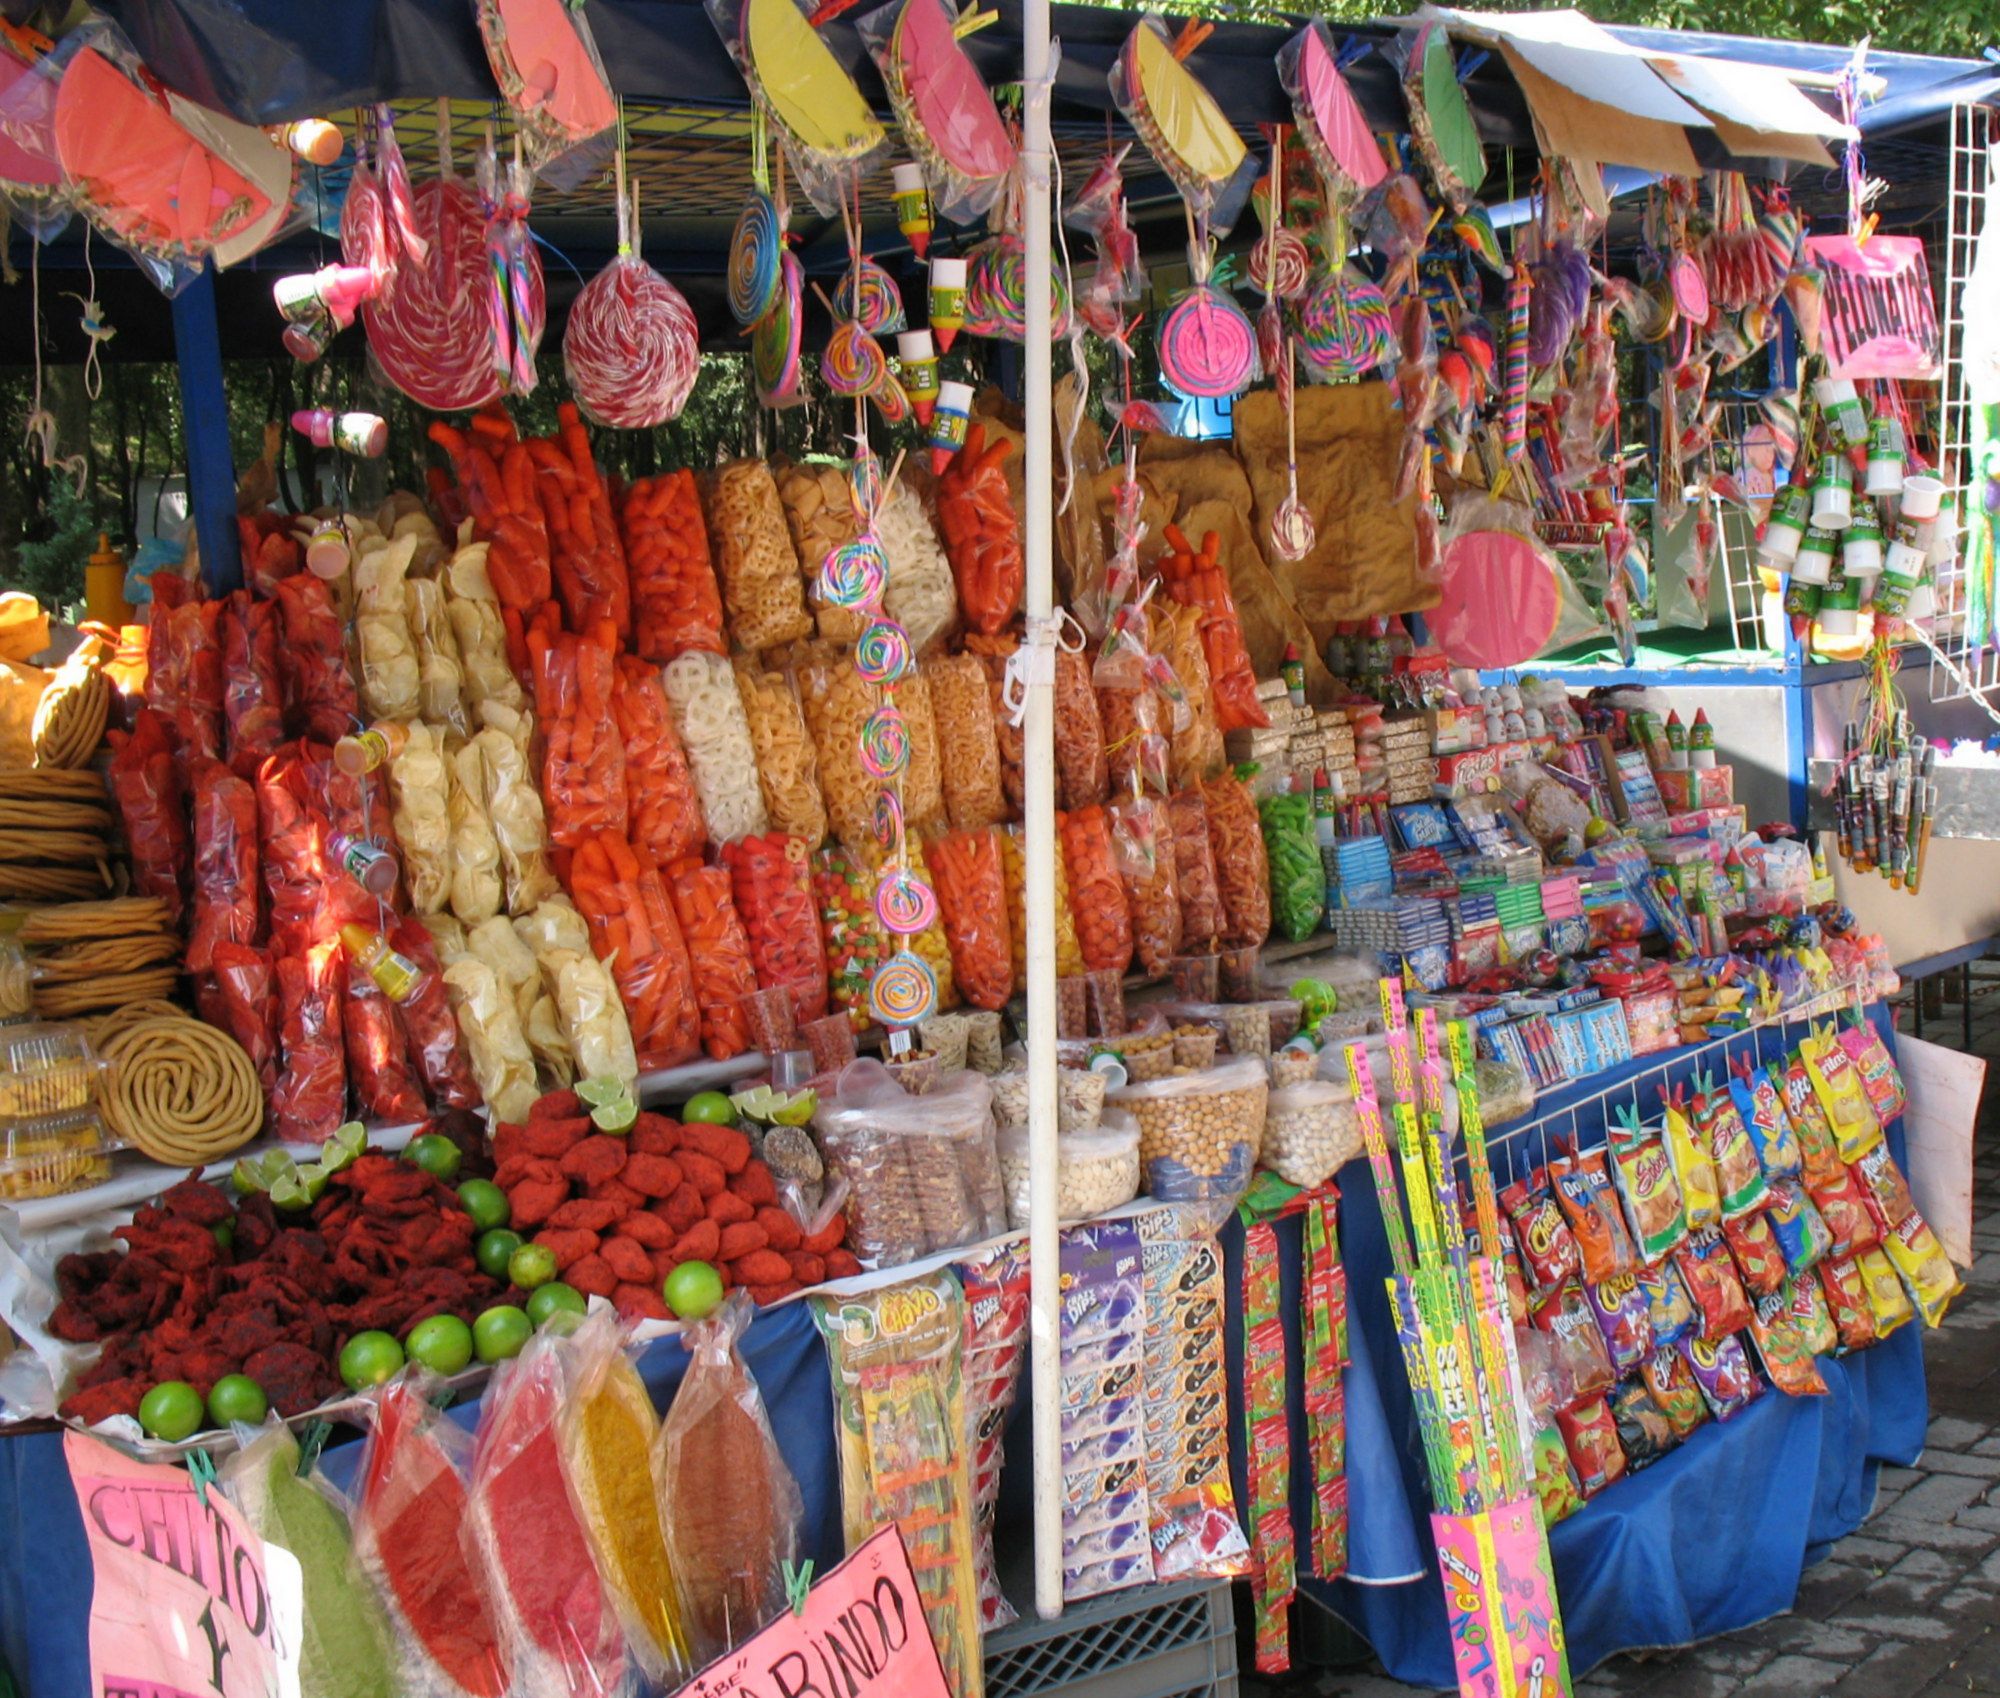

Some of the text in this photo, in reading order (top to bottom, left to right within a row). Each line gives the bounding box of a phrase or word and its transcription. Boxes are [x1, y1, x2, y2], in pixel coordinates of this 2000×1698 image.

[975, 1302, 1000, 1331] DIPS
[1069, 1294, 1098, 1325] DIPS
[1438, 1546, 1482, 1588] ONE
[1450, 1593, 1492, 1677] LONG
[1501, 1602, 1564, 1653] LONG
[1529, 1655, 1545, 1698] ON
